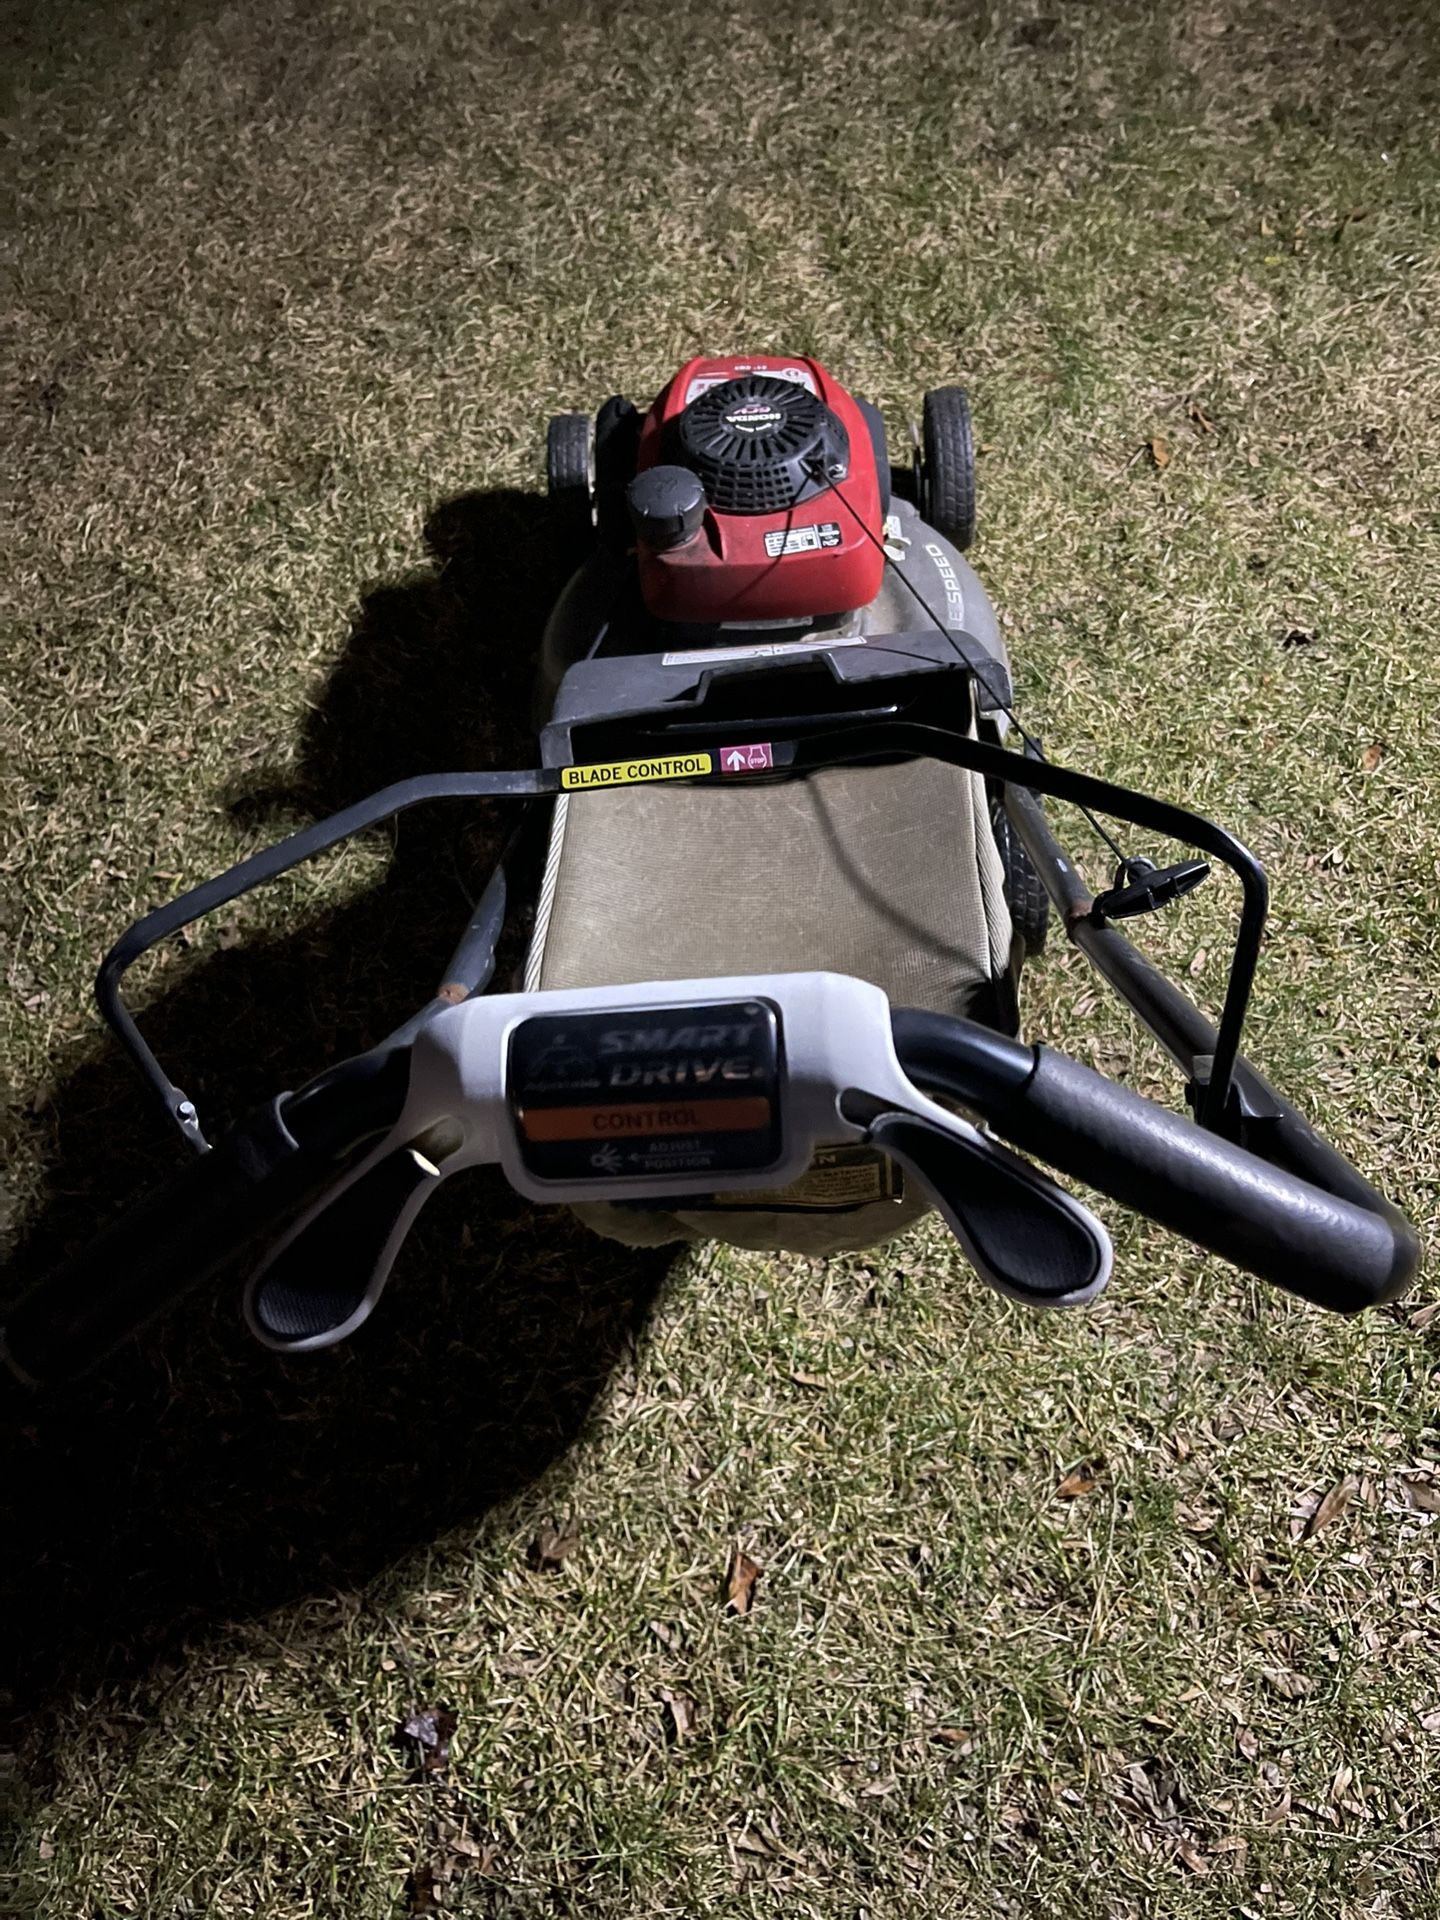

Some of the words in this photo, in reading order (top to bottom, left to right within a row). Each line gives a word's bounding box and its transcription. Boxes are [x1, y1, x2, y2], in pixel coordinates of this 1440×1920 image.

[726, 413, 781, 422] HONDA
[925, 543, 961, 604] SPEED
[569, 765, 622, 785] BLADE
[627, 758, 705, 778] CONTROL
[750, 756, 765, 765] STOP
[599, 1023, 755, 1055] SMART
[593, 1108, 701, 1131] CONTROL
